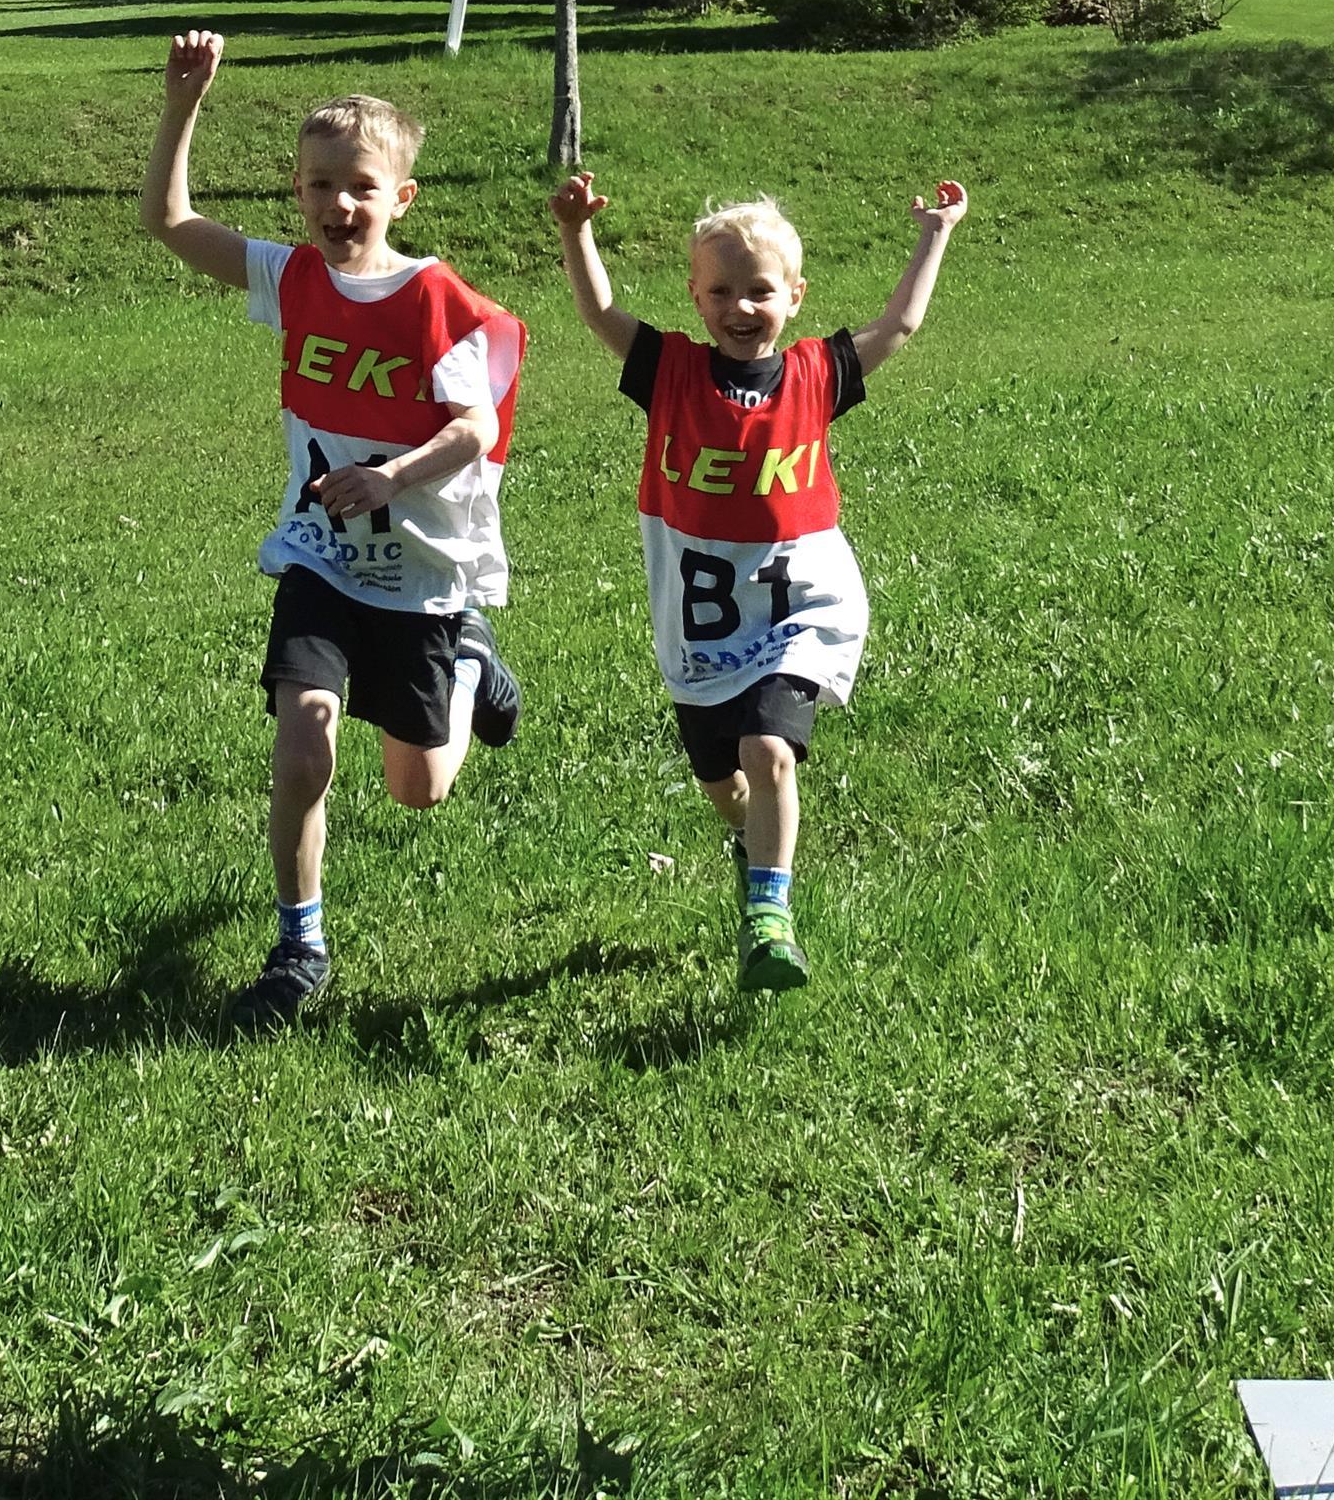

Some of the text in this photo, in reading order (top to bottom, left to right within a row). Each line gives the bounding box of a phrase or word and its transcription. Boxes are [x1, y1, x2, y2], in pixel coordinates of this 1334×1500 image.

[294, 437, 391, 534] A1
[659, 434, 821, 496] LEKI
[679, 547, 791, 642] B1
